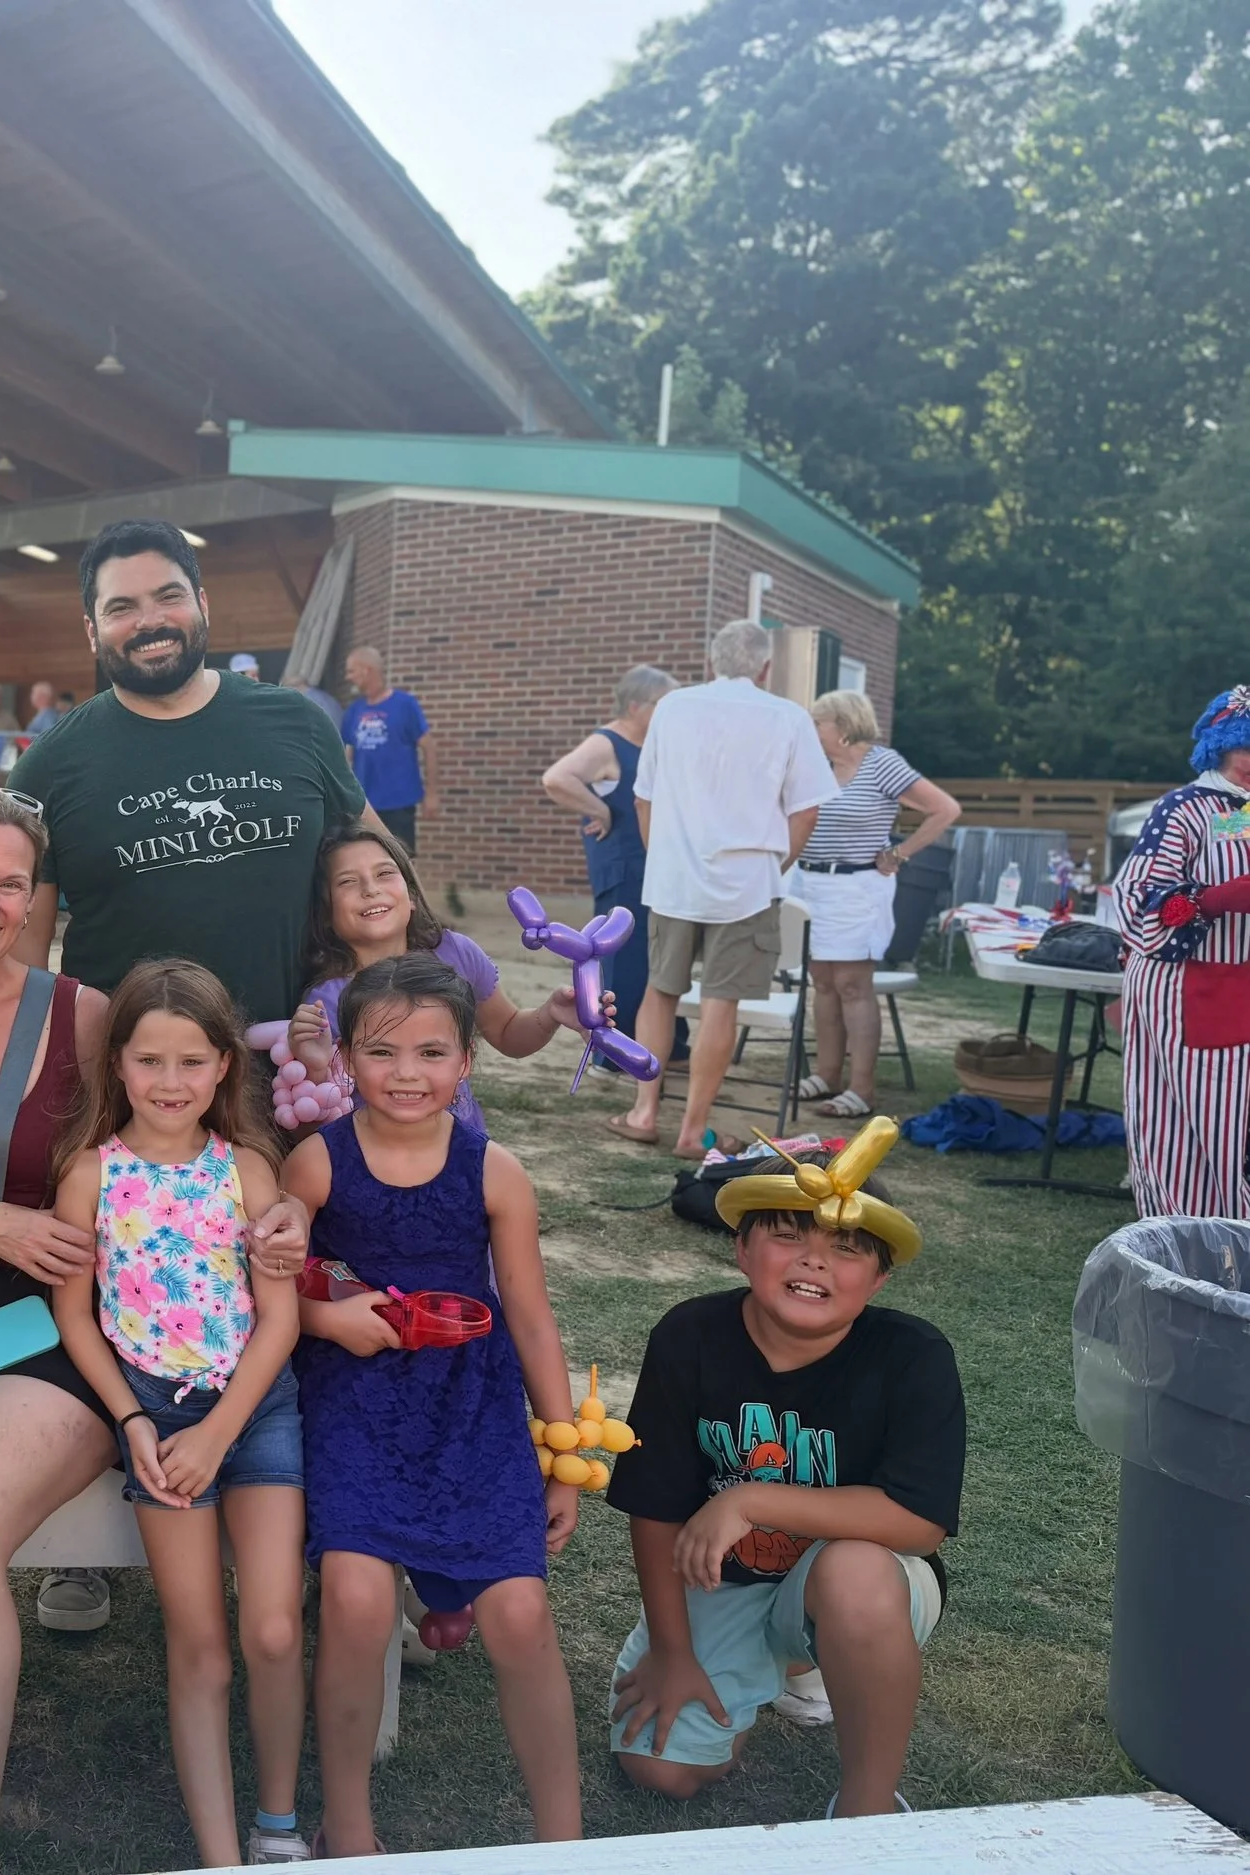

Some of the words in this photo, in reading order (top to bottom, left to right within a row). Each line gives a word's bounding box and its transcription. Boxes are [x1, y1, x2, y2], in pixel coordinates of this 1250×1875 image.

[117, 786, 180, 816] Cape
[185, 770, 283, 794] Charles
[155, 814, 173, 825] est.
[234, 801, 257, 810] 2022
[114, 830, 201, 868] MINI
[207, 815, 302, 848] GOLF
[696, 1402, 838, 1488] MAIN
